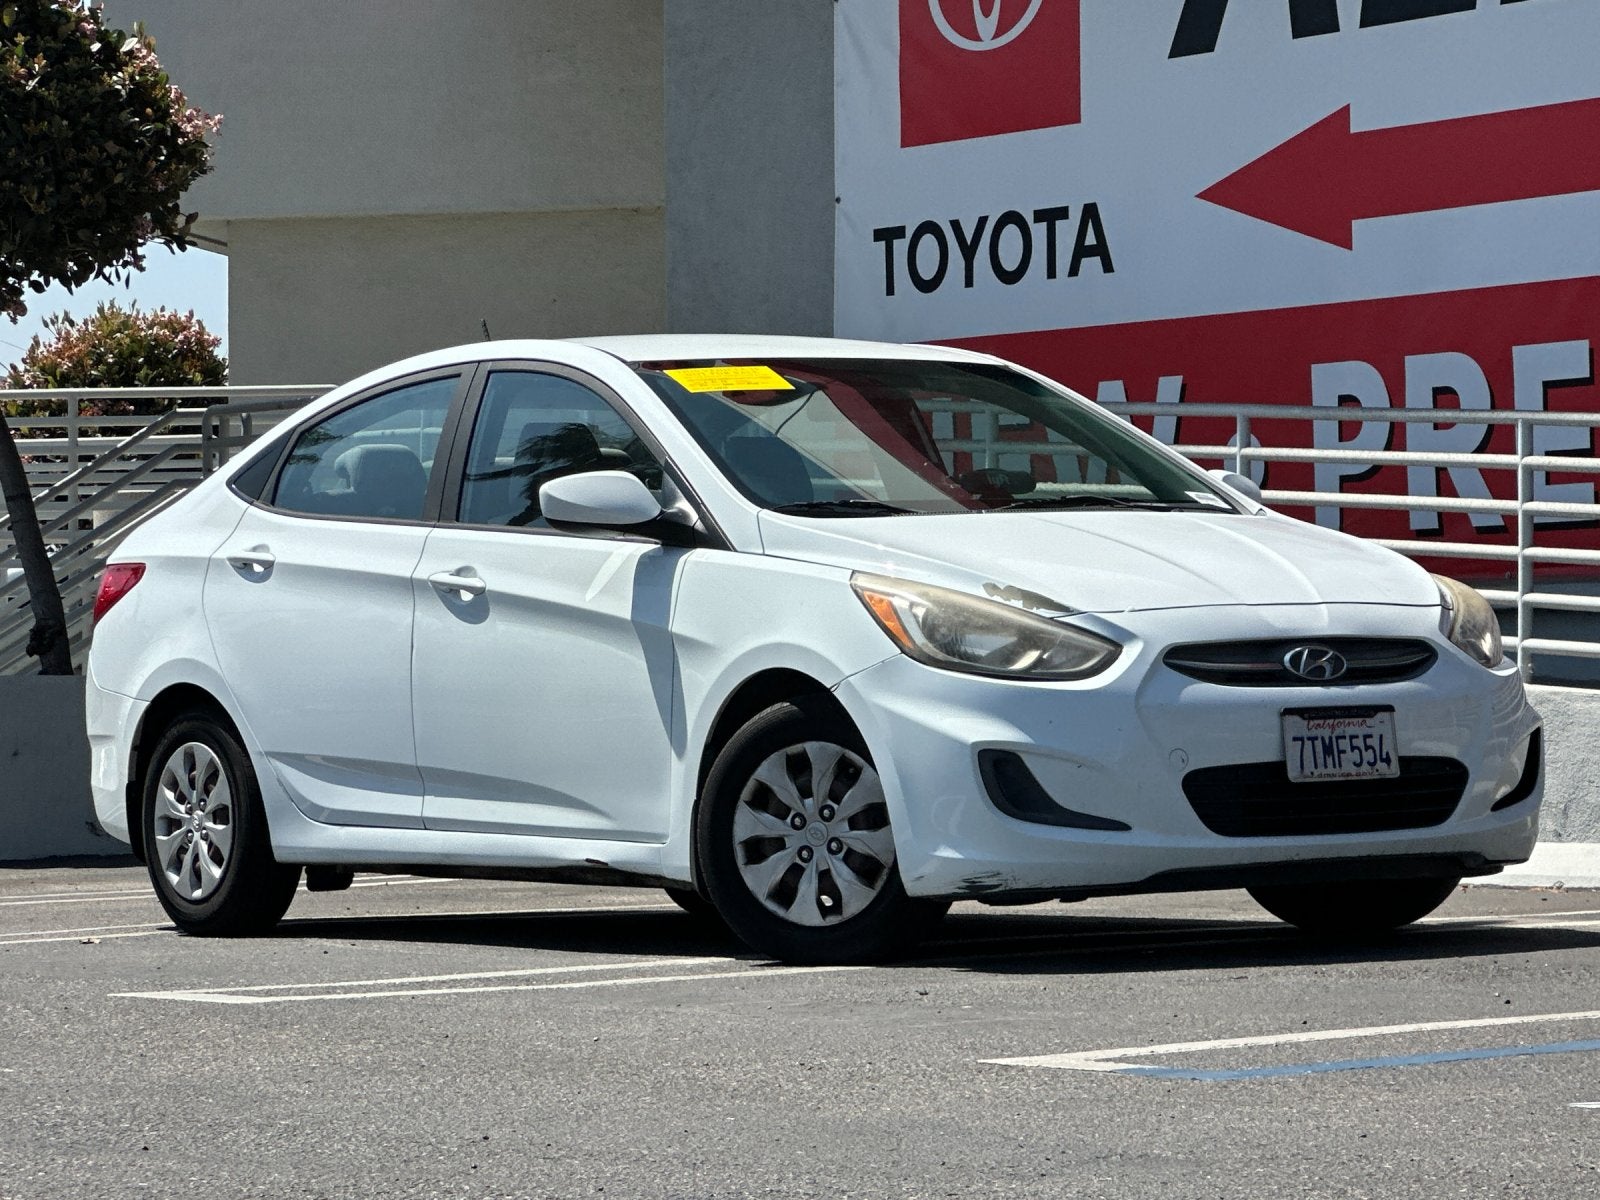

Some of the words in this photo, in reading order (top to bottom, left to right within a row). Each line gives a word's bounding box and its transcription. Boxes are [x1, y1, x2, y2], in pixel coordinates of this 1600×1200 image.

[873, 202, 1115, 296] TOYOTA
[1311, 339, 1595, 532] PRE
[1292, 734, 1392, 772] 7TMF554
[1306, 719, 1375, 733] California
